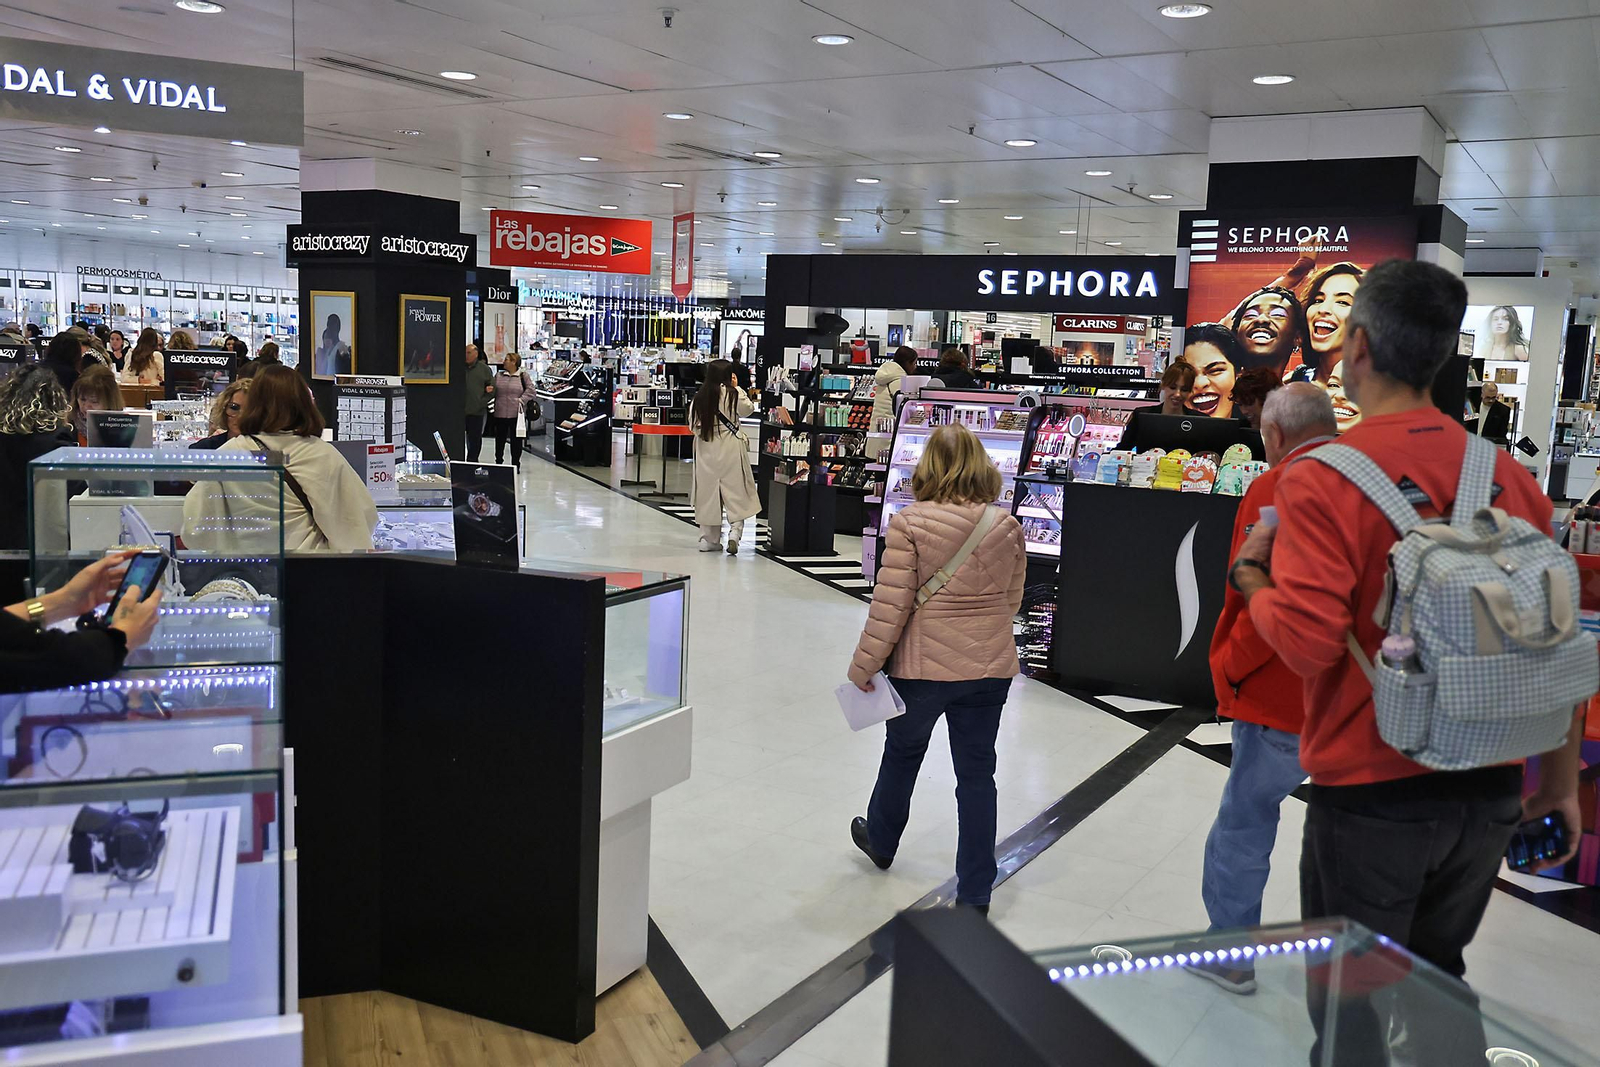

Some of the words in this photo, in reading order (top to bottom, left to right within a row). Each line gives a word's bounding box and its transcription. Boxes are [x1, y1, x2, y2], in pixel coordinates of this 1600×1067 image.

[87, 73, 114, 101] &
[122, 77, 227, 113] VIDAL
[495, 216, 519, 230] Las
[495, 223, 607, 260] rebajas
[1227, 225, 1349, 244] SEPHORA
[292, 232, 371, 255] aristocrazy
[381, 234, 469, 263] aristocrazy
[76, 265, 163, 280] DERMOCOSMÉTICA
[977, 268, 1159, 298] SEPHORA
[488, 286, 512, 301] Dior
[414, 313, 443, 323] POWER
[724, 308, 766, 319] LANCÔME
[986, 313, 996, 322] 16
[1062, 318, 1118, 329] CLARINS
[169, 354, 230, 366] aristocrazy
[1058, 366, 1092, 374] SEPHORA
[1092, 367, 1141, 376] COLLECTION
[370, 471, 393, 483] -50%
